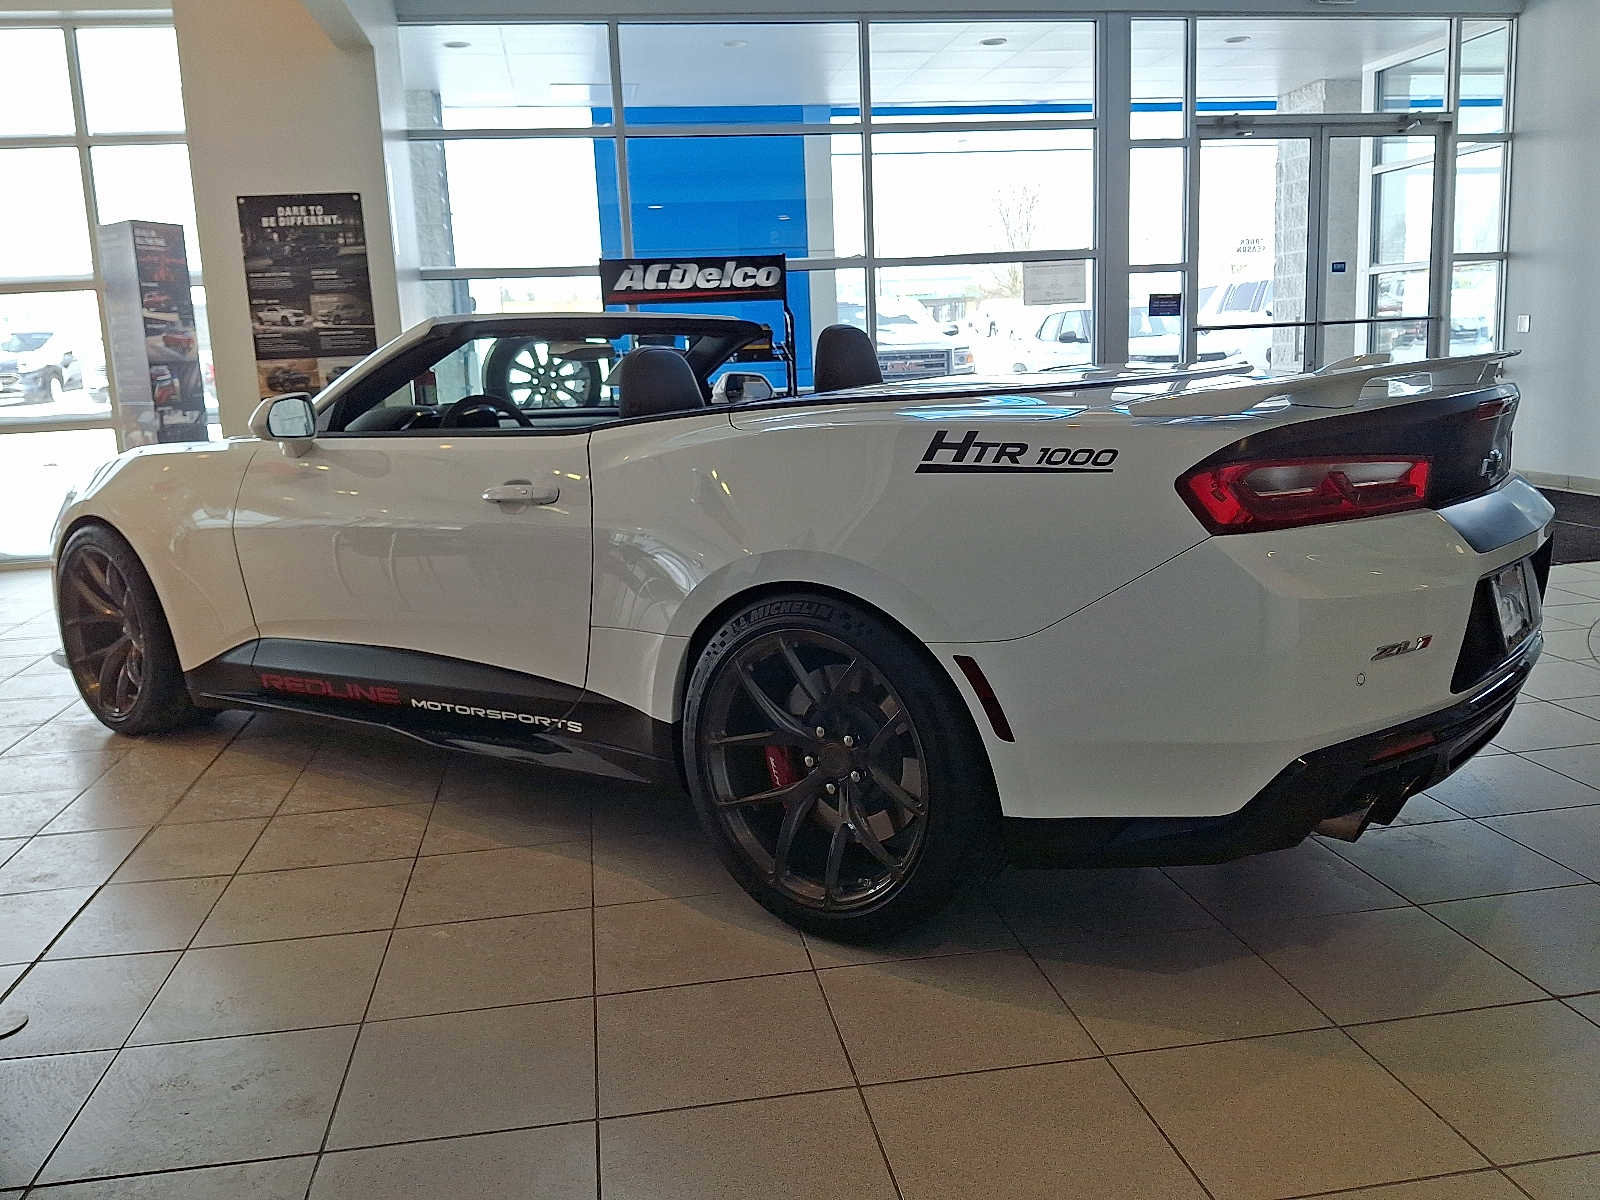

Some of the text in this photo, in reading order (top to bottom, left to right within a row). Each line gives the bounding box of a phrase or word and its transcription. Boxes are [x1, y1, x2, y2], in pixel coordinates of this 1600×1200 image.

[261, 217, 277, 227] BE
[277, 205, 323, 216] DARE TO
[613, 261, 781, 291] ACDelco
[921, 430, 1120, 467] HTR 1000
[751, 600, 834, 622] MICHELIN
[260, 673, 583, 733] REDLINE MOTORSPORTS
